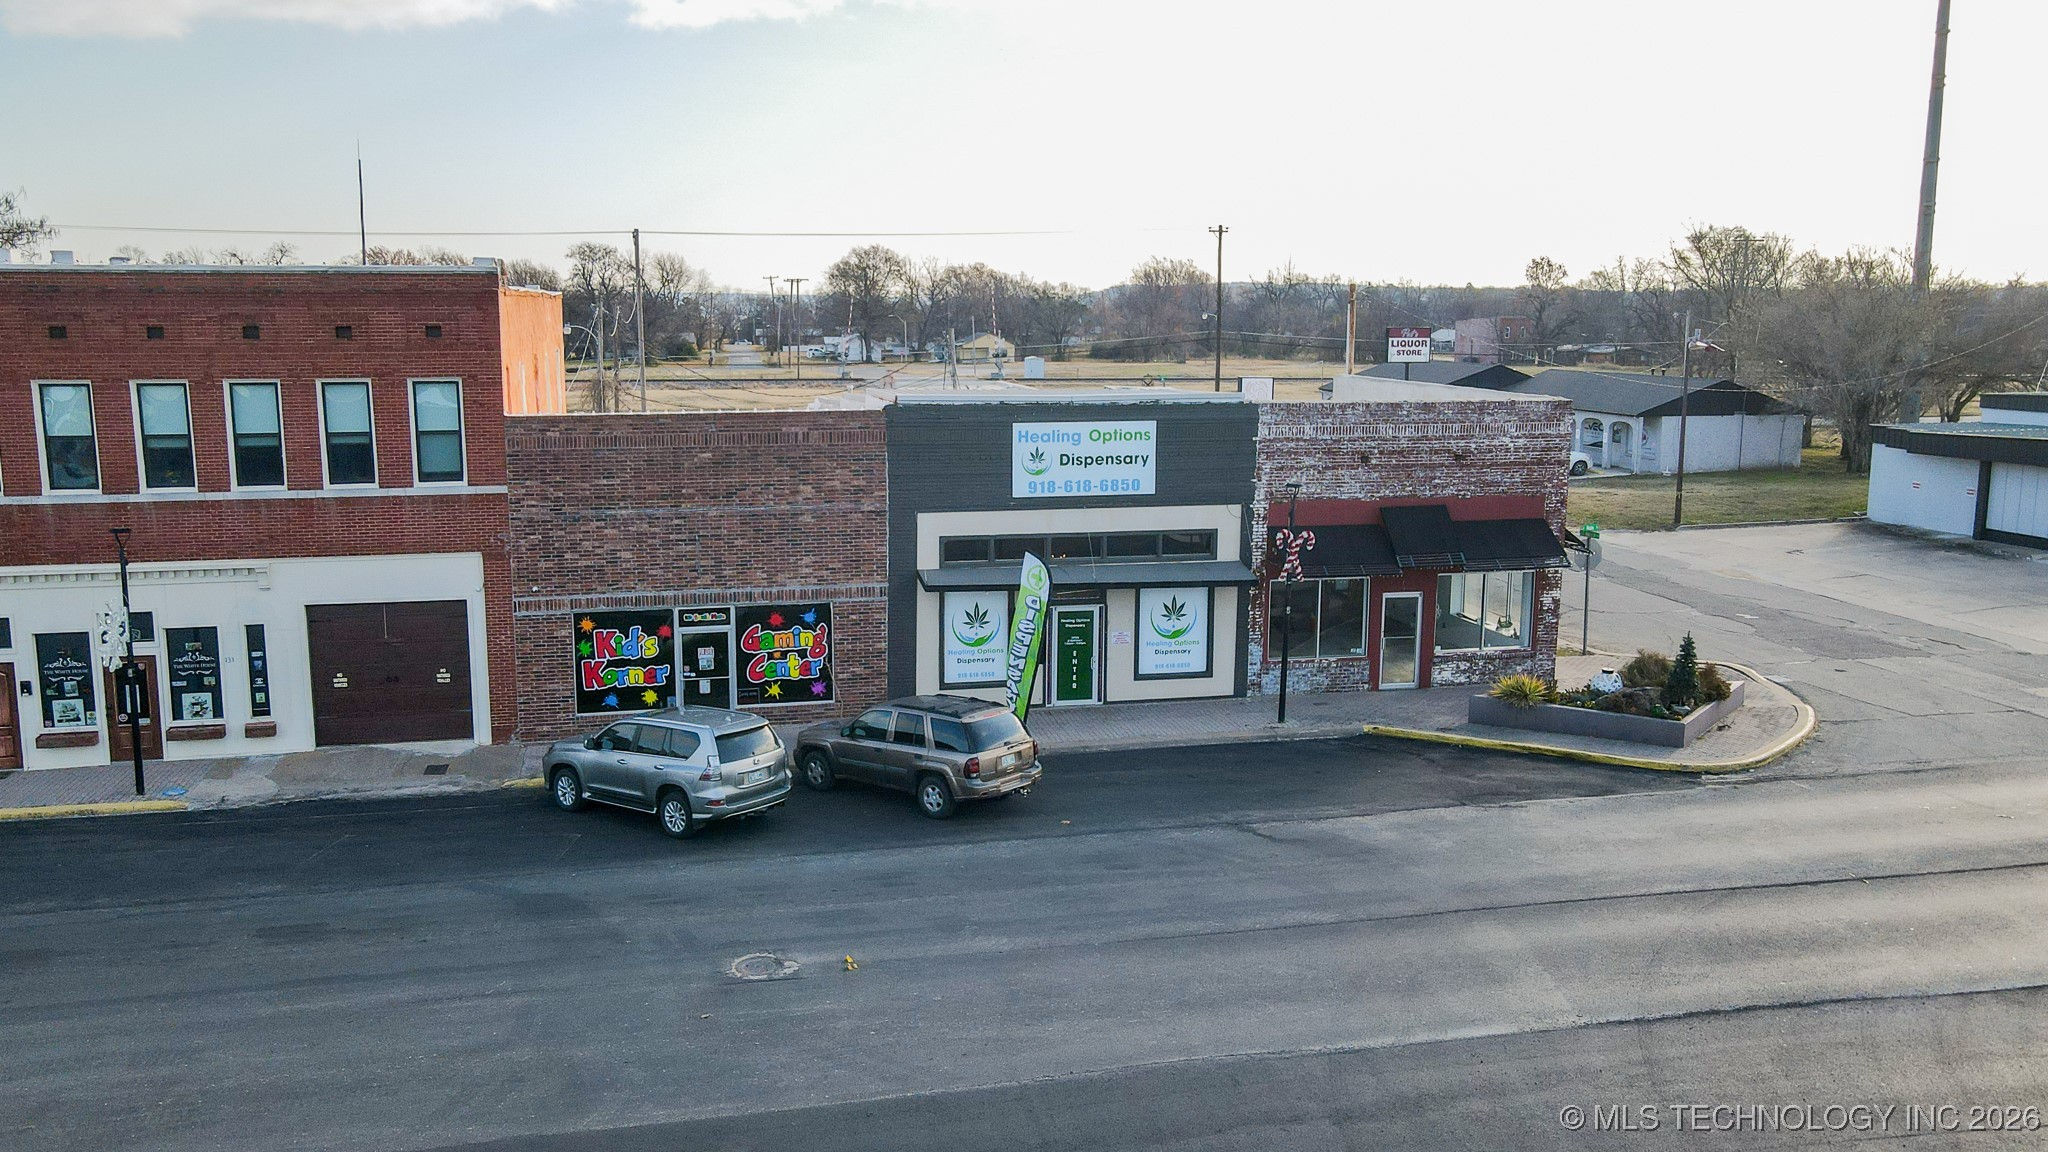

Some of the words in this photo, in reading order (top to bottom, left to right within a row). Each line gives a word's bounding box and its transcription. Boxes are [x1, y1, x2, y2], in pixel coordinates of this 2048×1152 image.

[1017, 430, 1081, 446] Healing
[1089, 429, 1151, 444] Options
[1059, 453, 1149, 468] Dispensary
[1028, 479, 1140, 494] 918-618-6850
[594, 626, 660, 660] Kid's
[741, 622, 828, 660] Gaming
[1006, 595, 1041, 713] DISPENSARY
[581, 659, 670, 691] Korner
[746, 653, 823, 683] Center
